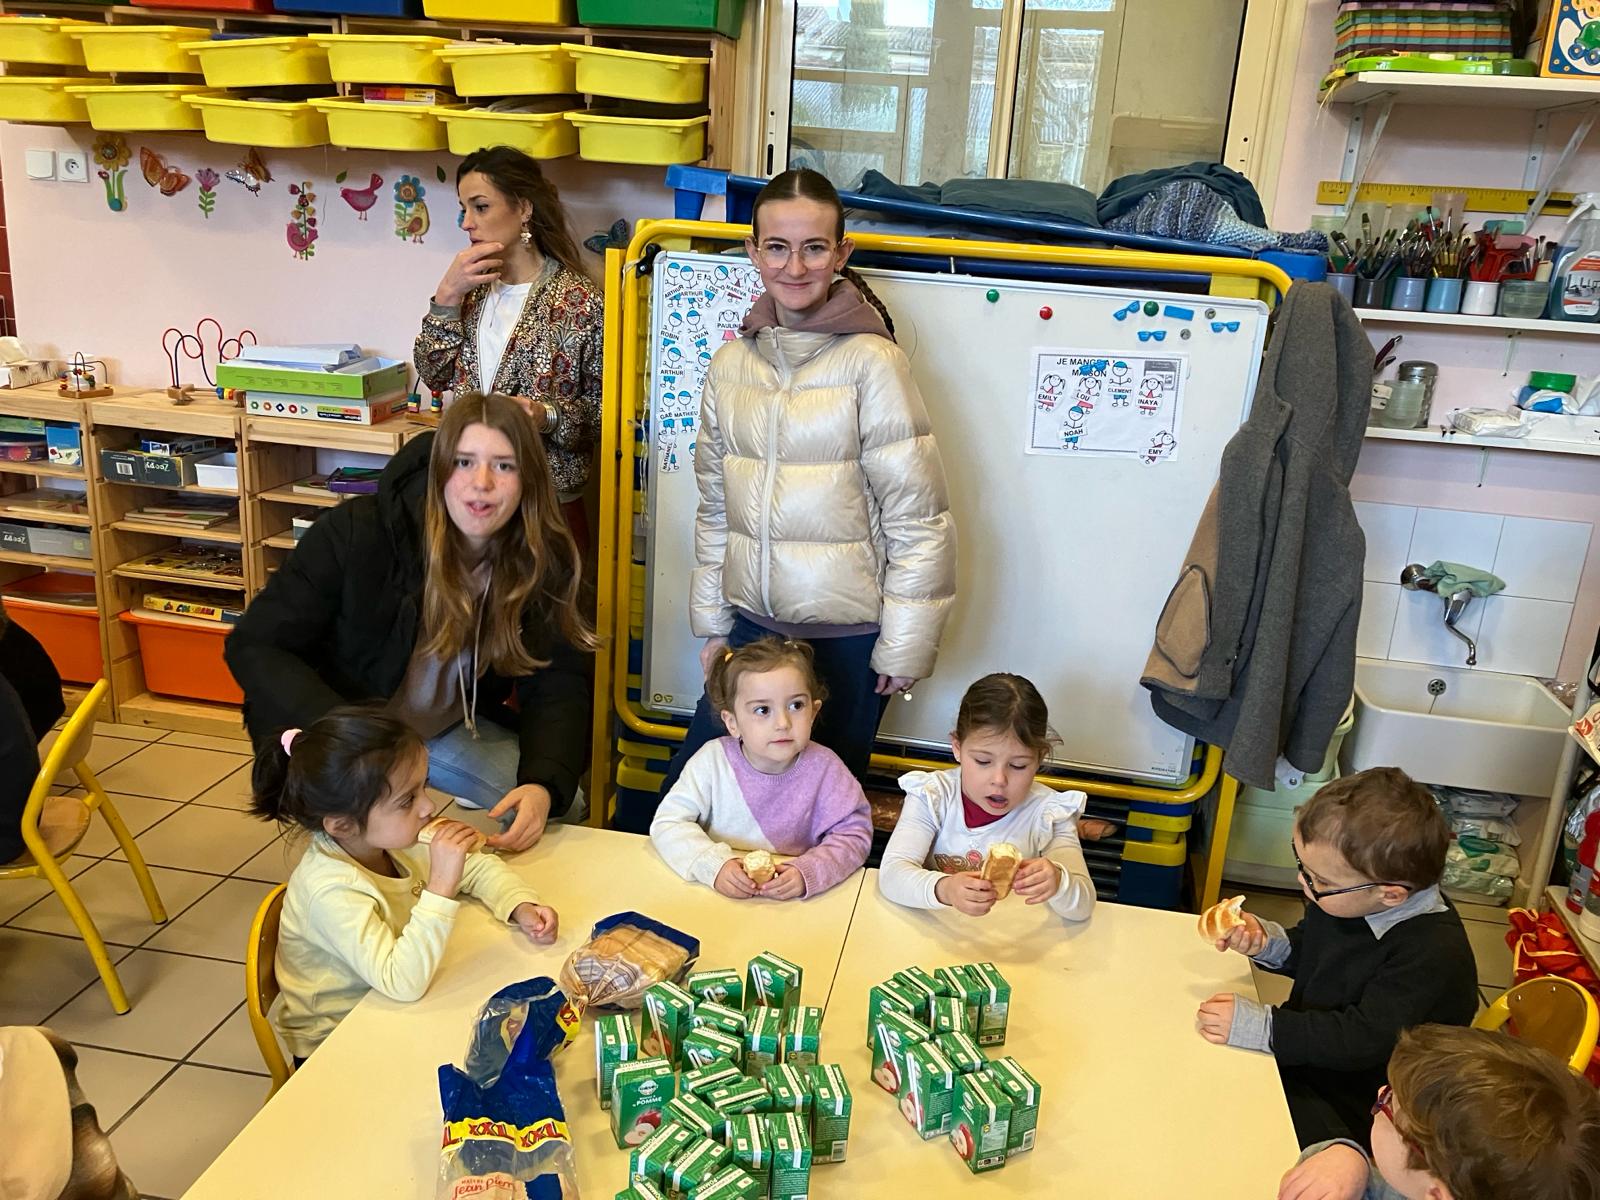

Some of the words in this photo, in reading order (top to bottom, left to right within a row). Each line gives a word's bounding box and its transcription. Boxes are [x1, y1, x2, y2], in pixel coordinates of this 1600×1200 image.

[660, 331, 680, 341] ROBIN
[1056, 357, 1068, 365] JE
[1069, 358, 1096, 366] MANG
[1072, 369, 1107, 377] MSON
[1037, 393, 1058, 401] EMILY
[1076, 392, 1090, 401] LOU
[1064, 428, 1083, 437] NOAH
[636, 1097, 662, 1106] POMME
[468, 1121, 516, 1141] XXL
[520, 1121, 567, 1148] XXL
